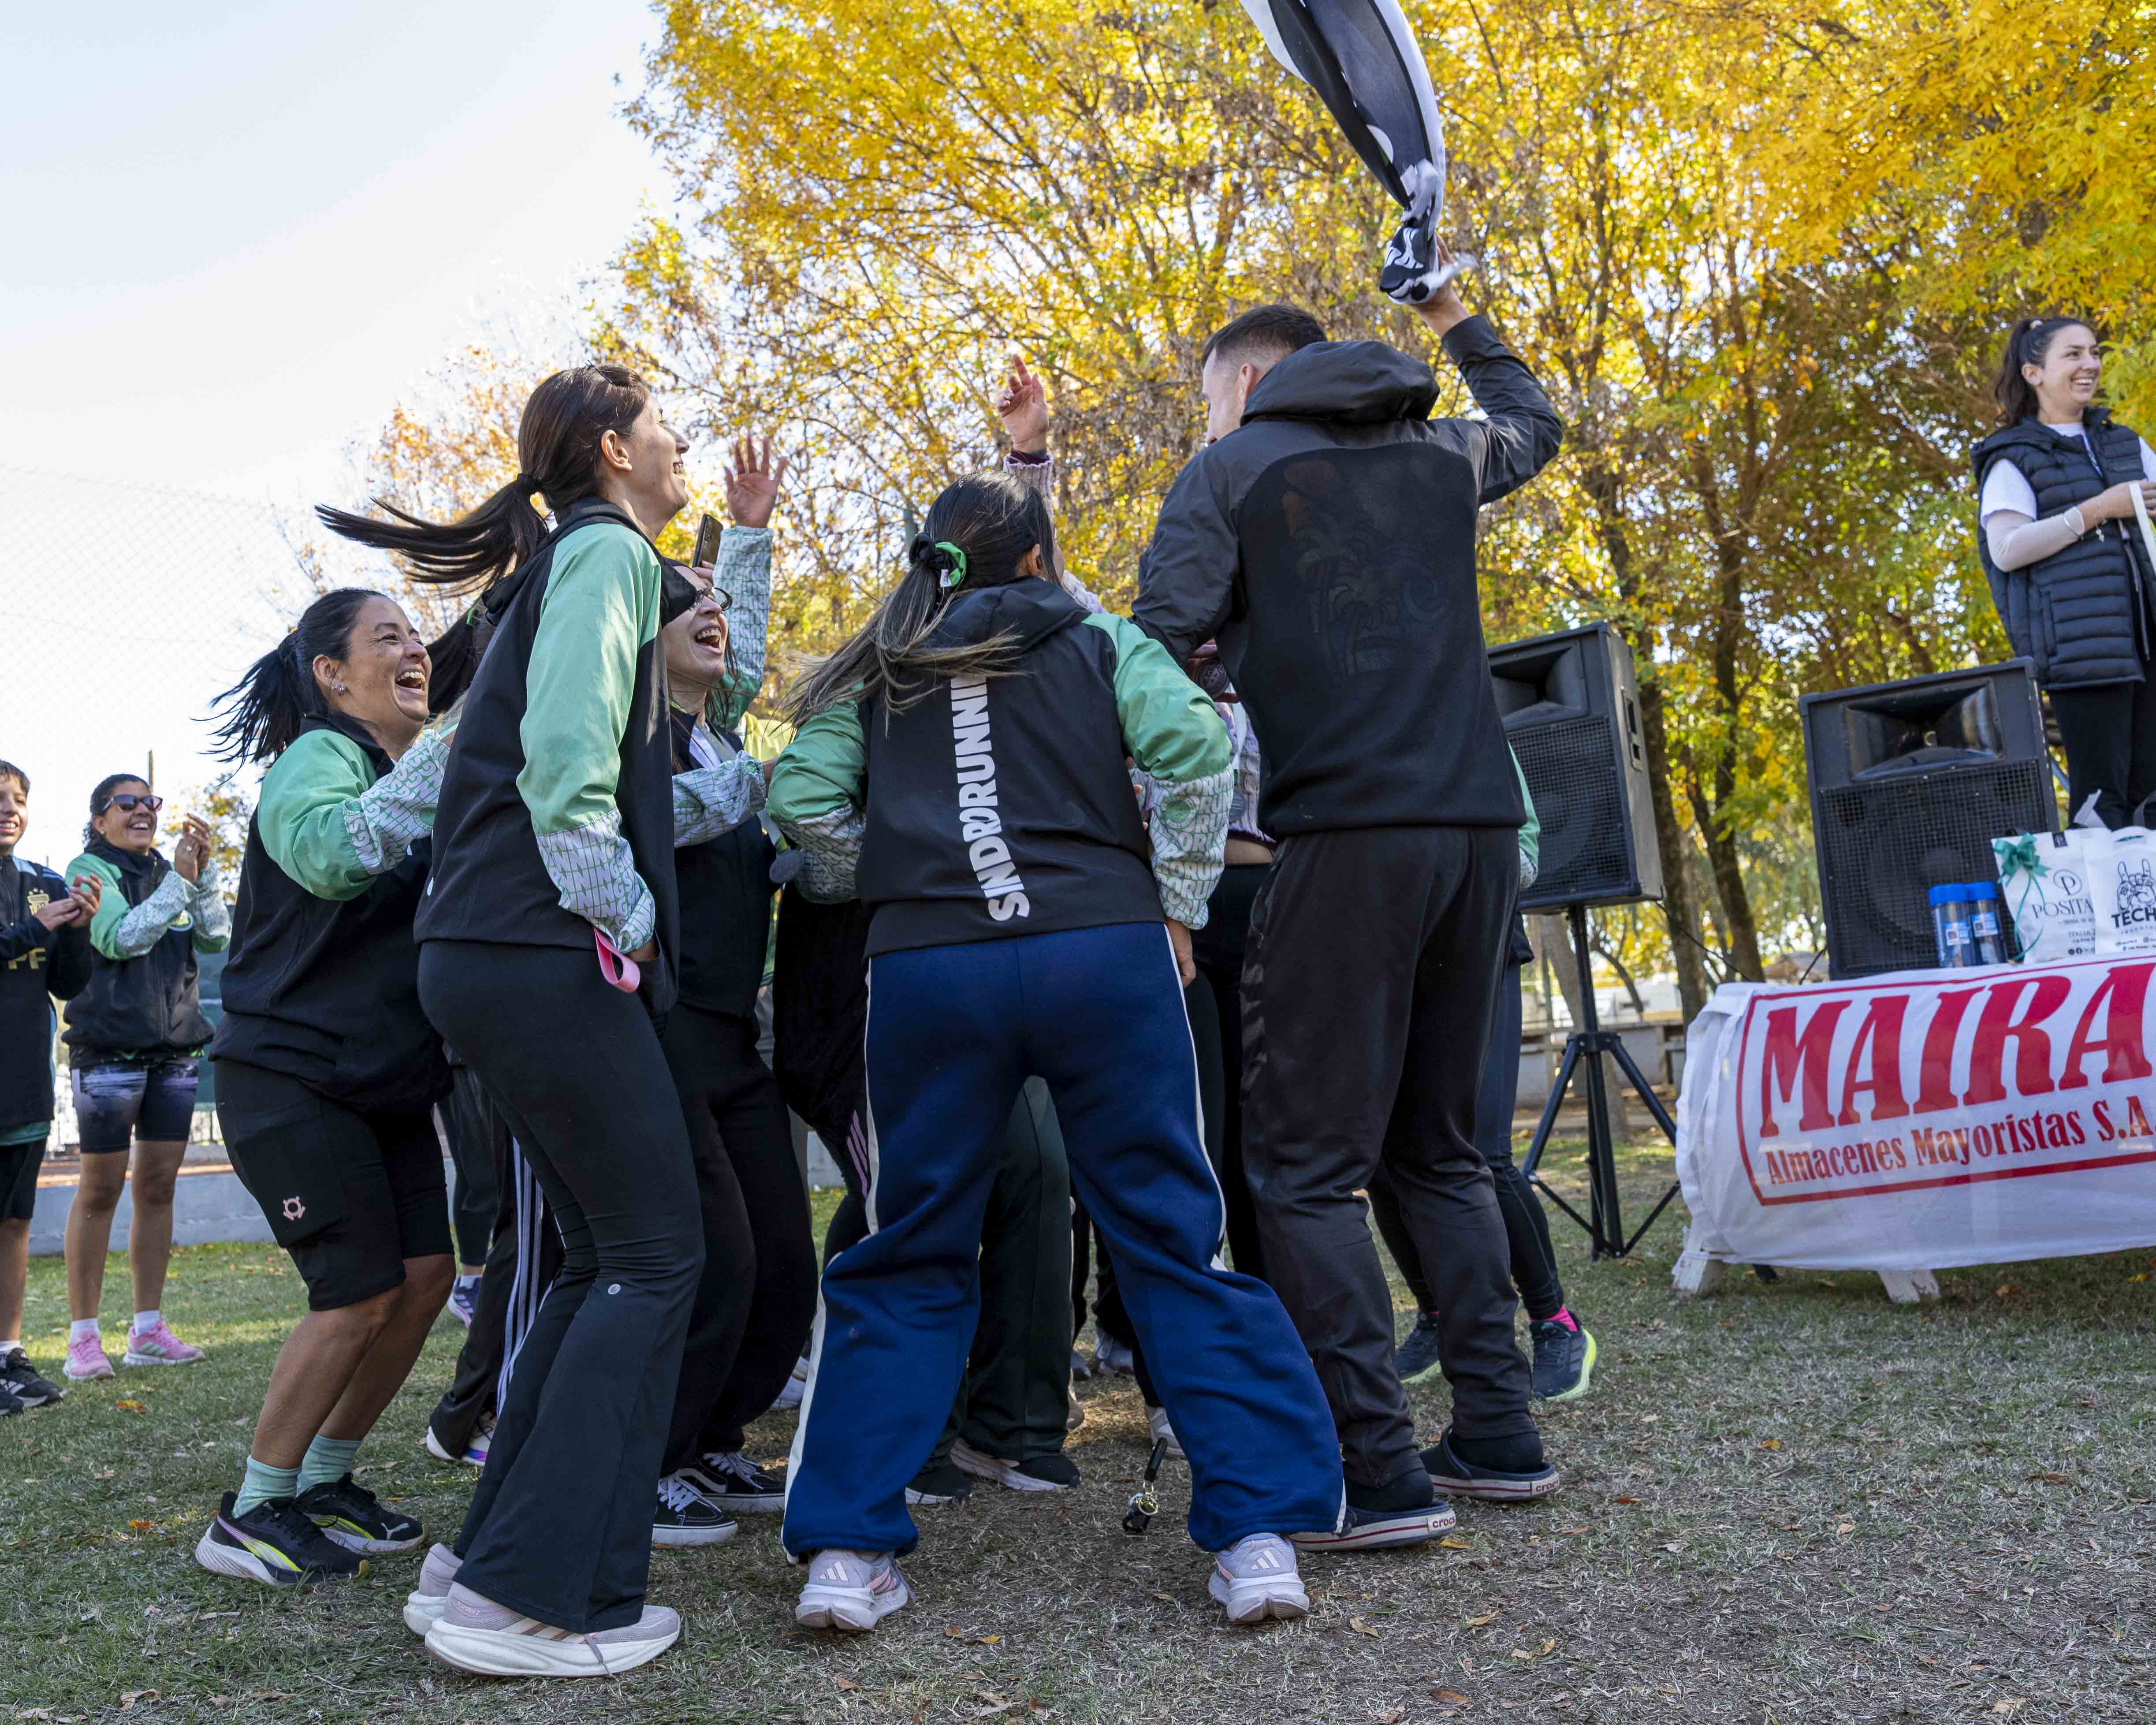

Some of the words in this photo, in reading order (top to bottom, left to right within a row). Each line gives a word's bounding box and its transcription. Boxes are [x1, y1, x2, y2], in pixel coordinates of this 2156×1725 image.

[1760, 963, 2156, 1138] MAIRA
[1765, 1136, 1907, 1185] Almacenes
[1911, 1110, 2085, 1165] Mayoristas
[2092, 1095, 2156, 1142] S.A
